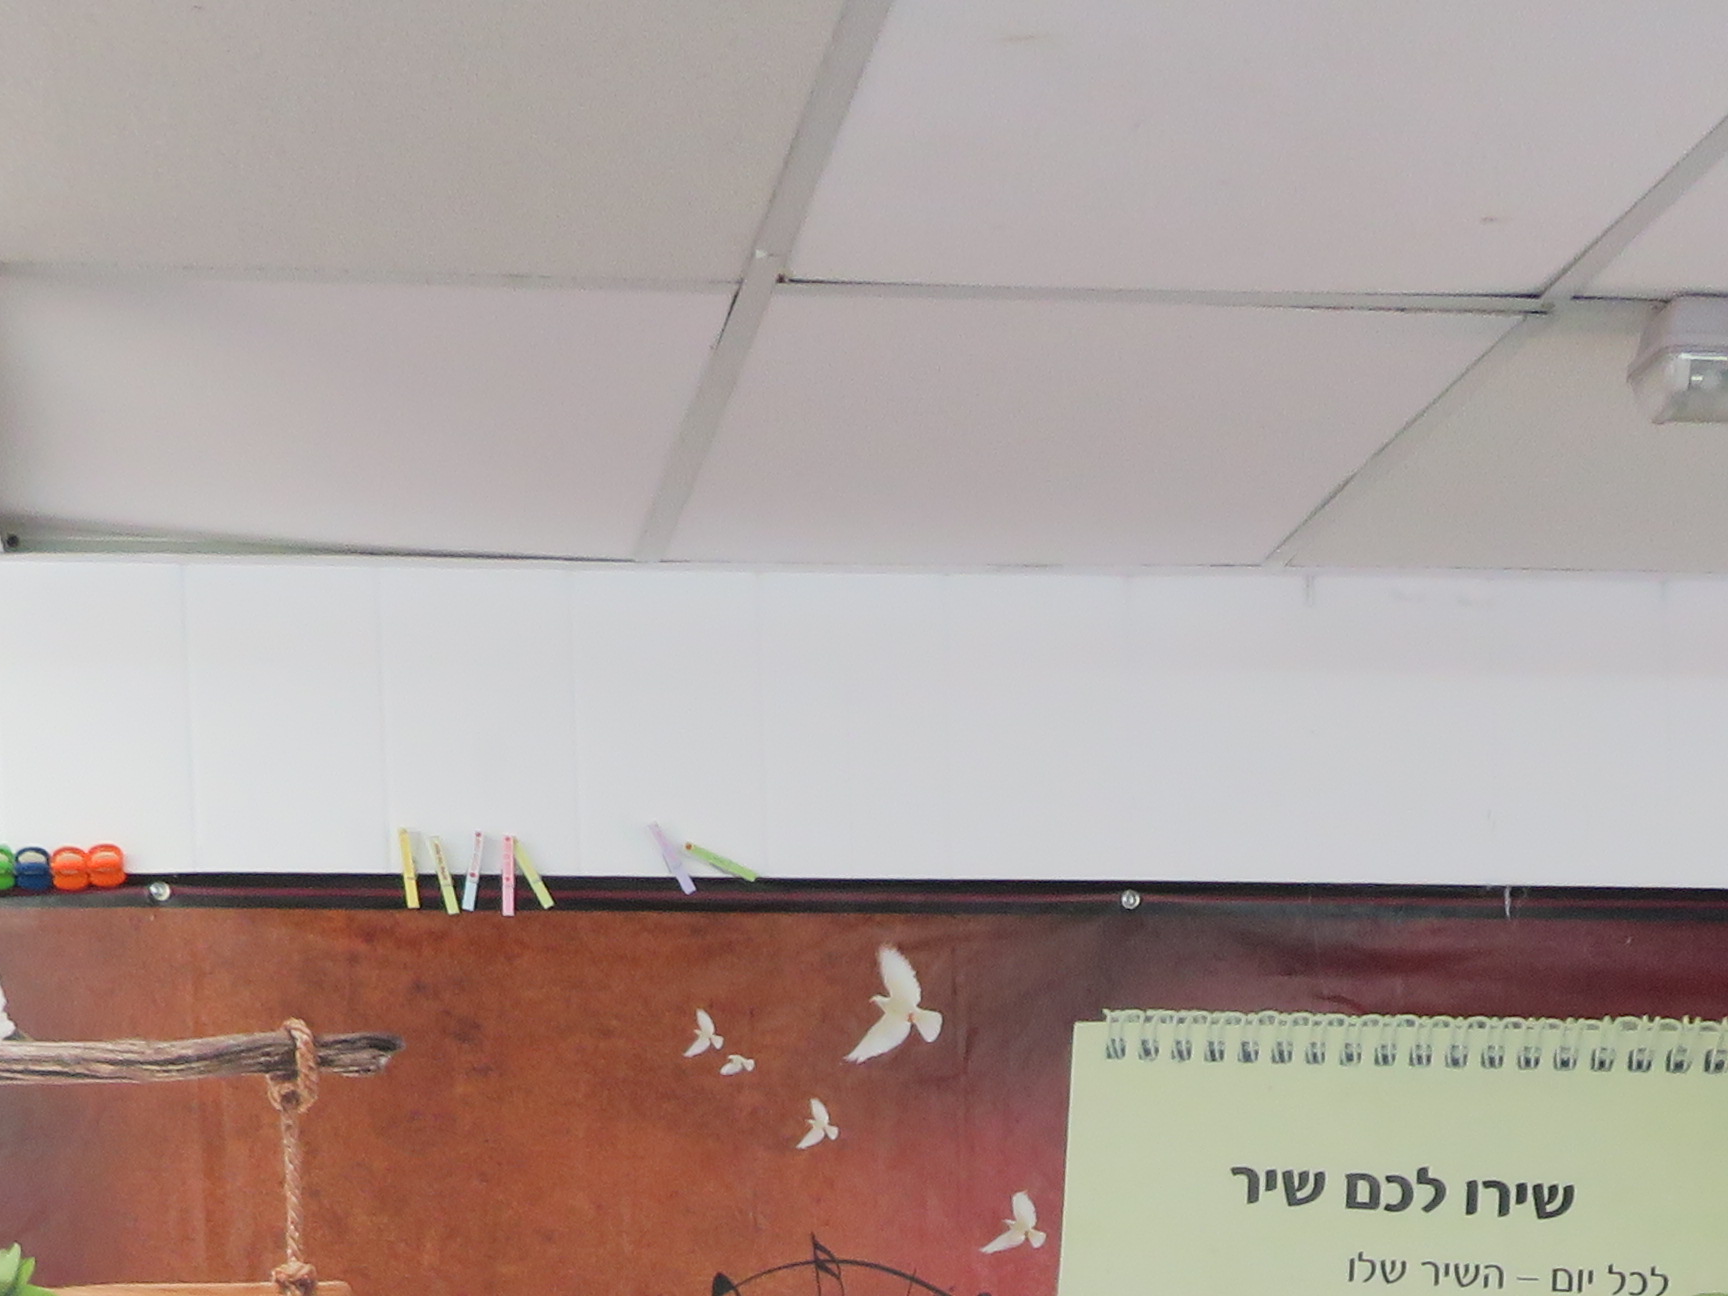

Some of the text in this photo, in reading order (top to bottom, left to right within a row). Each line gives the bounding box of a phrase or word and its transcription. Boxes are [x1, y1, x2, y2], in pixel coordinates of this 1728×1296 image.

[1229, 1166, 1575, 1221] שירו לכם שיר
[1347, 1251, 1407, 1285] שלו
[1420, 1260, 1505, 1290] השיר
[1551, 1267, 1594, 1294] יום
